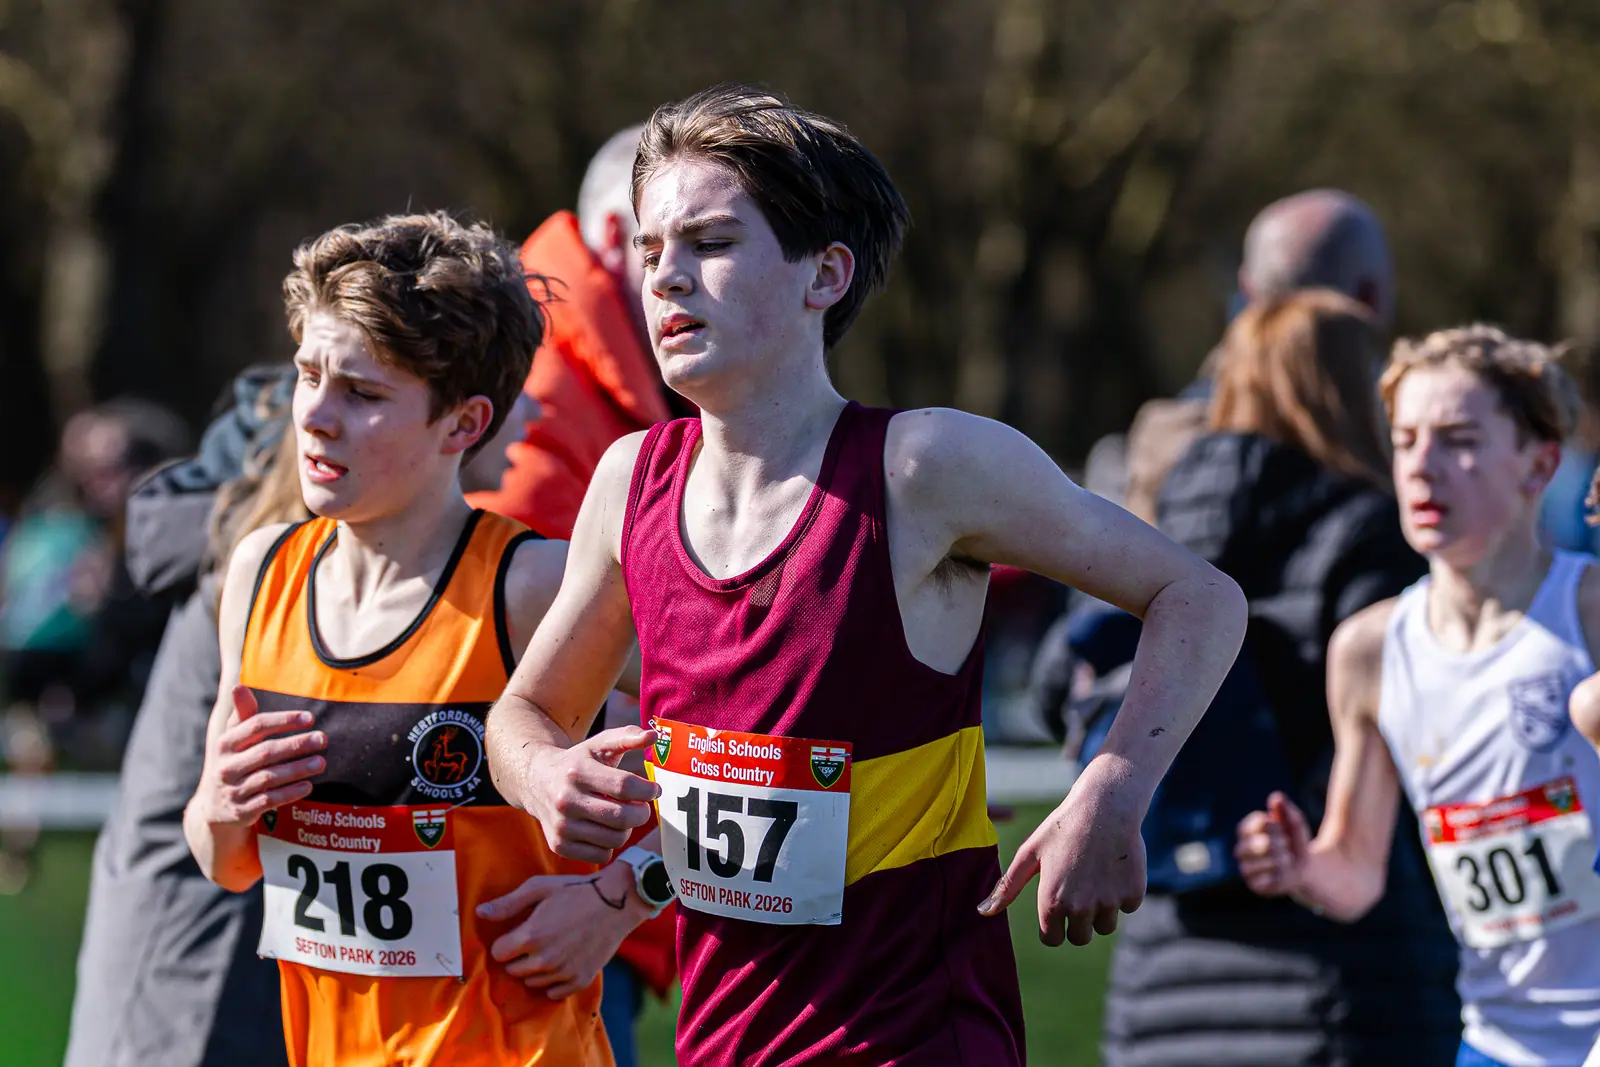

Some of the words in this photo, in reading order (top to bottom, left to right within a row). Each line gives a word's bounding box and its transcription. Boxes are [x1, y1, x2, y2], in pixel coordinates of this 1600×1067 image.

[688, 732, 725, 753] English
[728, 739, 782, 760] Schools
[690, 757, 720, 777] Cross
[723, 763, 774, 786] Country
[411, 777, 463, 798] SCHOOLS
[467, 777, 482, 792] AA
[292, 805, 332, 825] English
[334, 812, 386, 828] Schools
[297, 828, 328, 846] Cross
[330, 833, 381, 852] Country
[677, 786, 798, 883] 157
[1456, 837, 1560, 912] 301
[287, 854, 413, 941] 218
[680, 878, 716, 903] SEFTON
[719, 887, 751, 909] PARK
[754, 894, 793, 913] 2026
[294, 937, 336, 960] SEFTON
[340, 946, 375, 965] PARK
[378, 950, 416, 966] 2026
